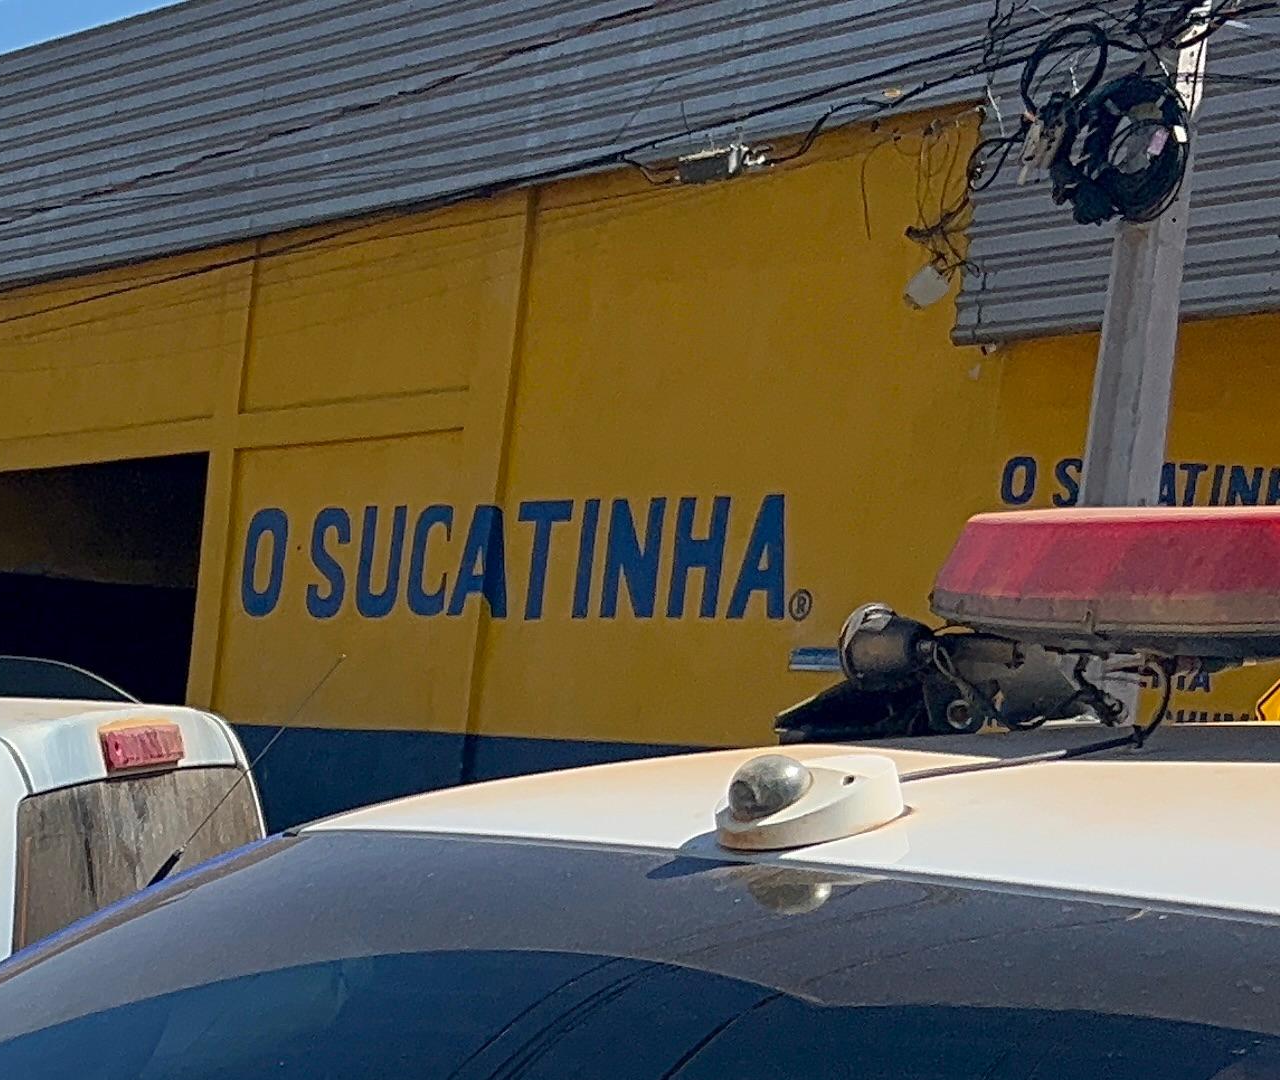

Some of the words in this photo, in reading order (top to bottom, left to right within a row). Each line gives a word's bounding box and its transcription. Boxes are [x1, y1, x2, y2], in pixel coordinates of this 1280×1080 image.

[1000, 456, 1037, 505] O
[1052, 458, 1280, 507] SATIN
[241, 506, 288, 618] O
[305, 494, 786, 620] SUCATINHA
